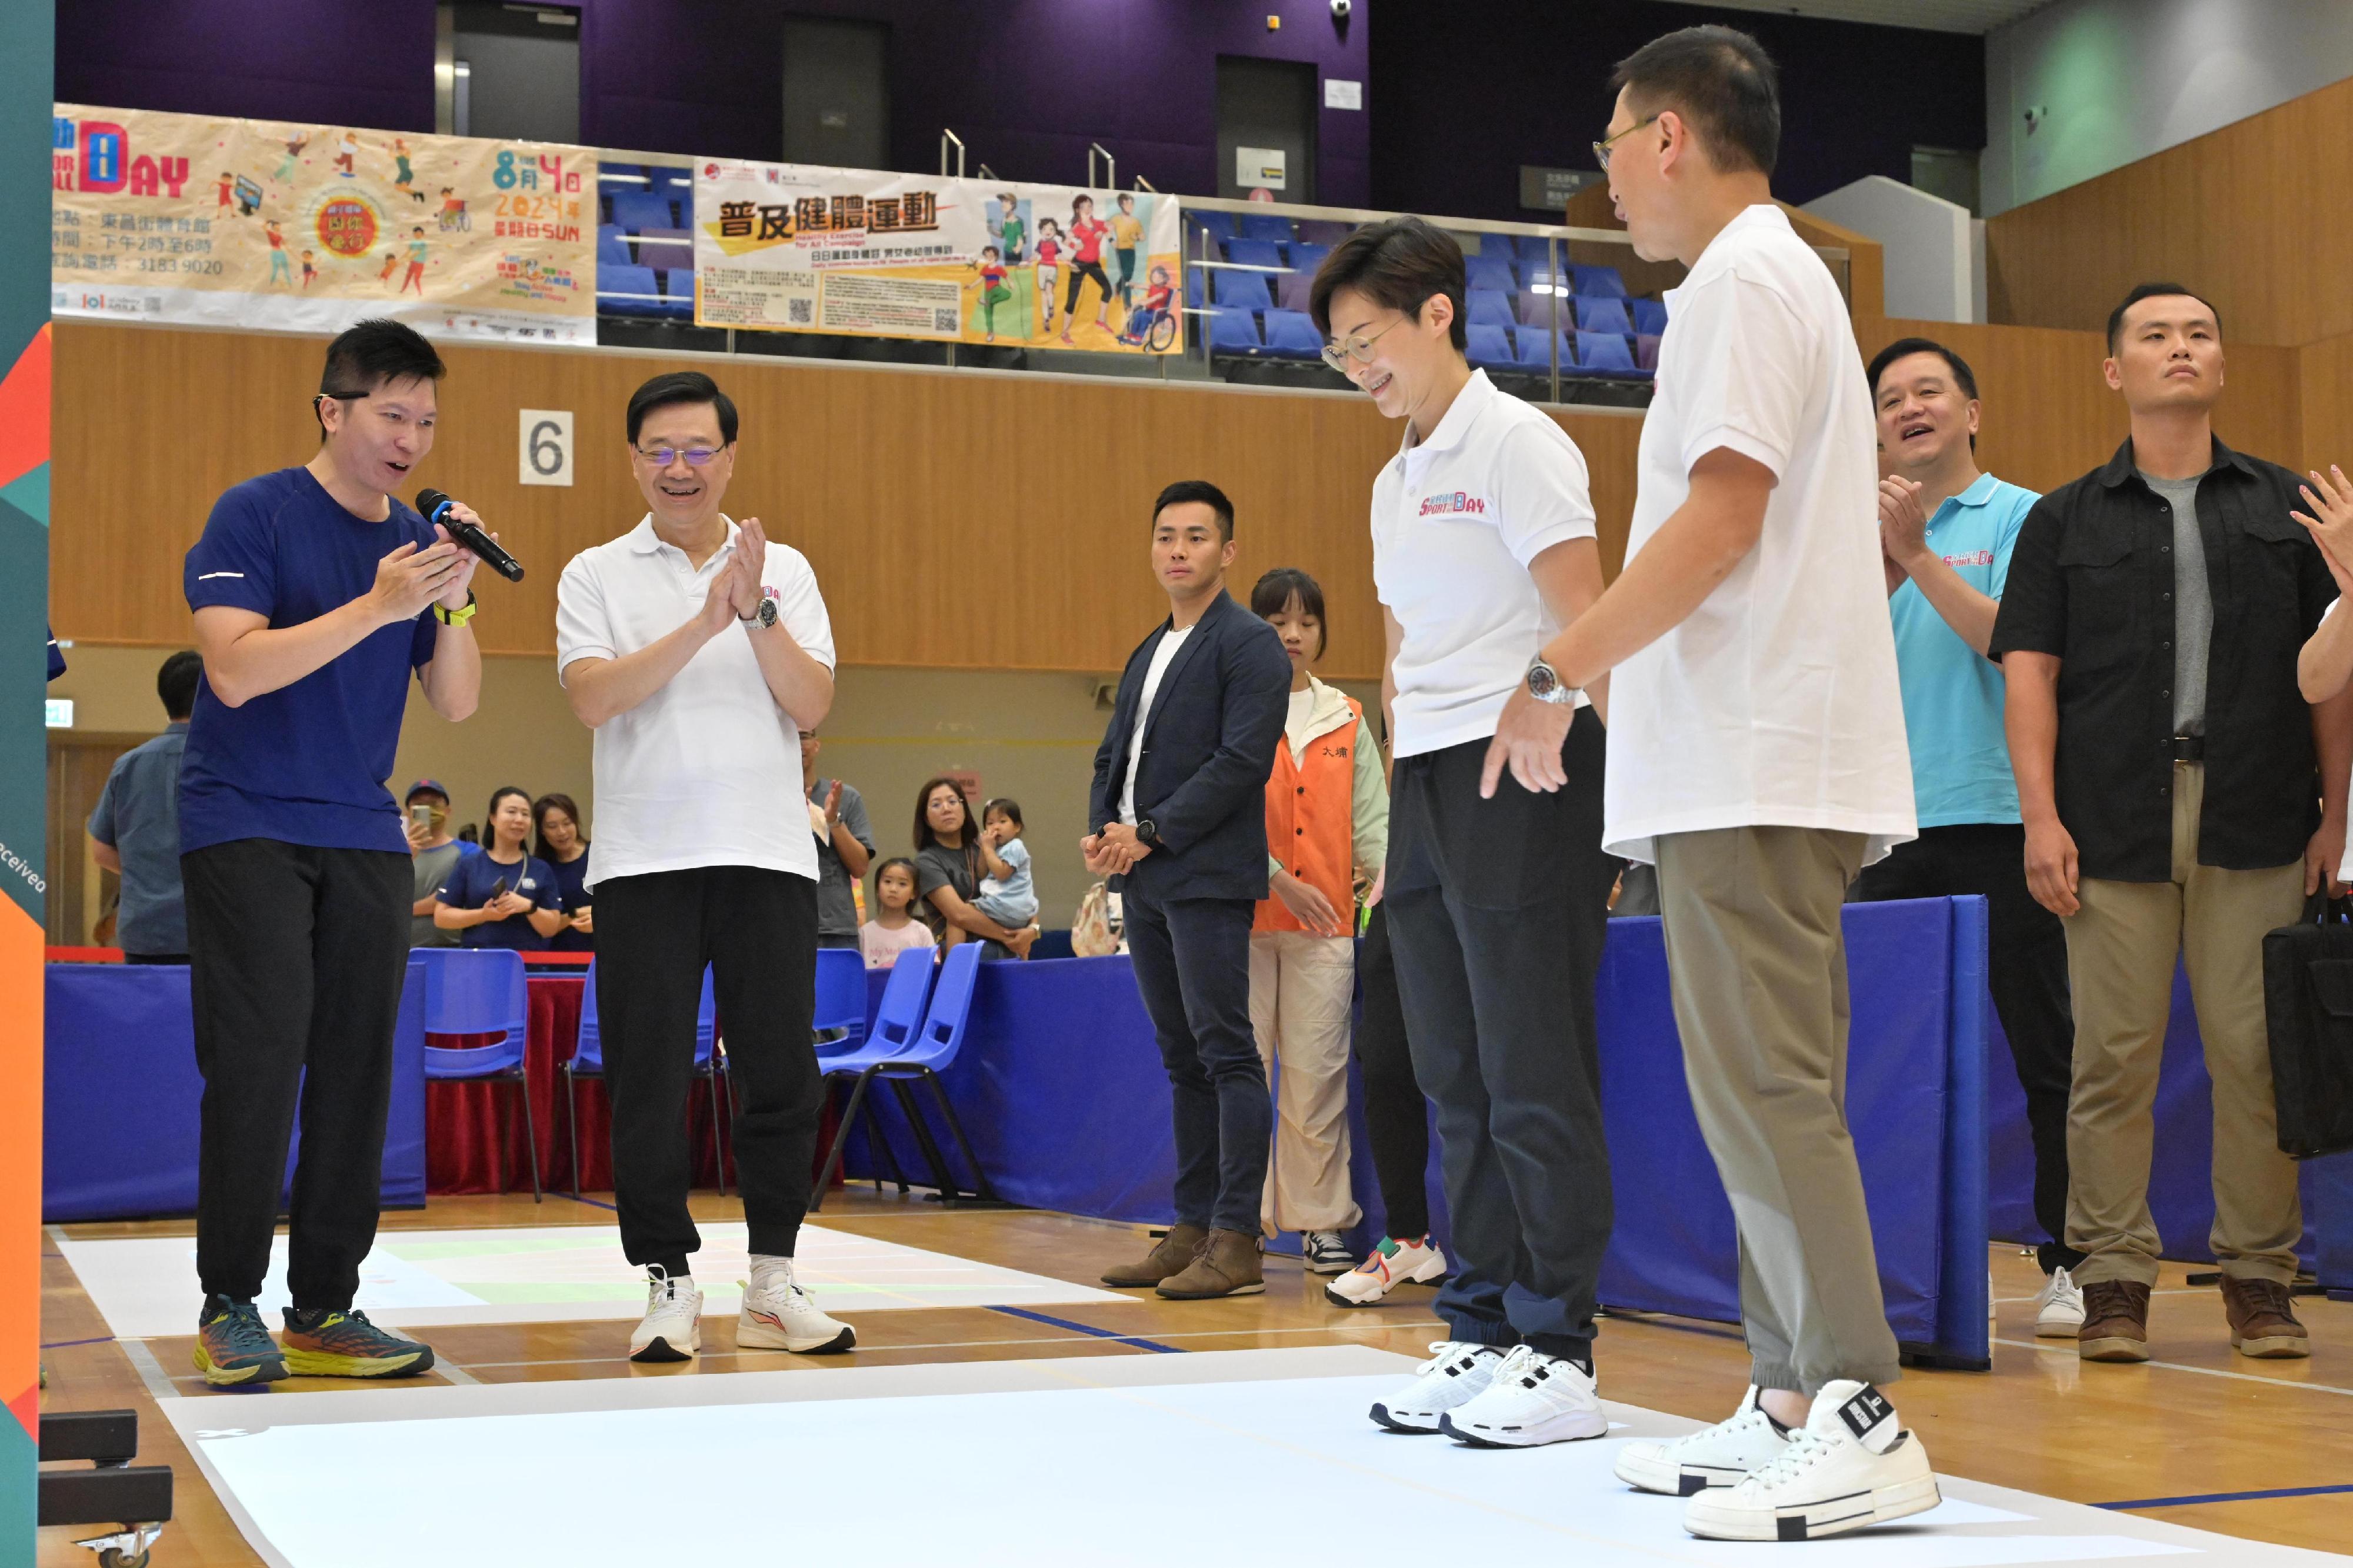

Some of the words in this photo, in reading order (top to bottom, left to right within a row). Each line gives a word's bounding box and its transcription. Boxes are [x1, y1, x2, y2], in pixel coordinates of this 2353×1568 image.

[52, 155, 75, 171] OR
[79, 121, 189, 198] DAY
[719, 191, 939, 240] 普及健體運動
[181, 259, 223, 275] 9020
[529, 421, 562, 475] 6
[1419, 497, 1447, 516] SPORT
[1453, 492, 1485, 513] DAY
[1978, 551, 1994, 566] DA
[1322, 746, 1348, 758] 大埔
